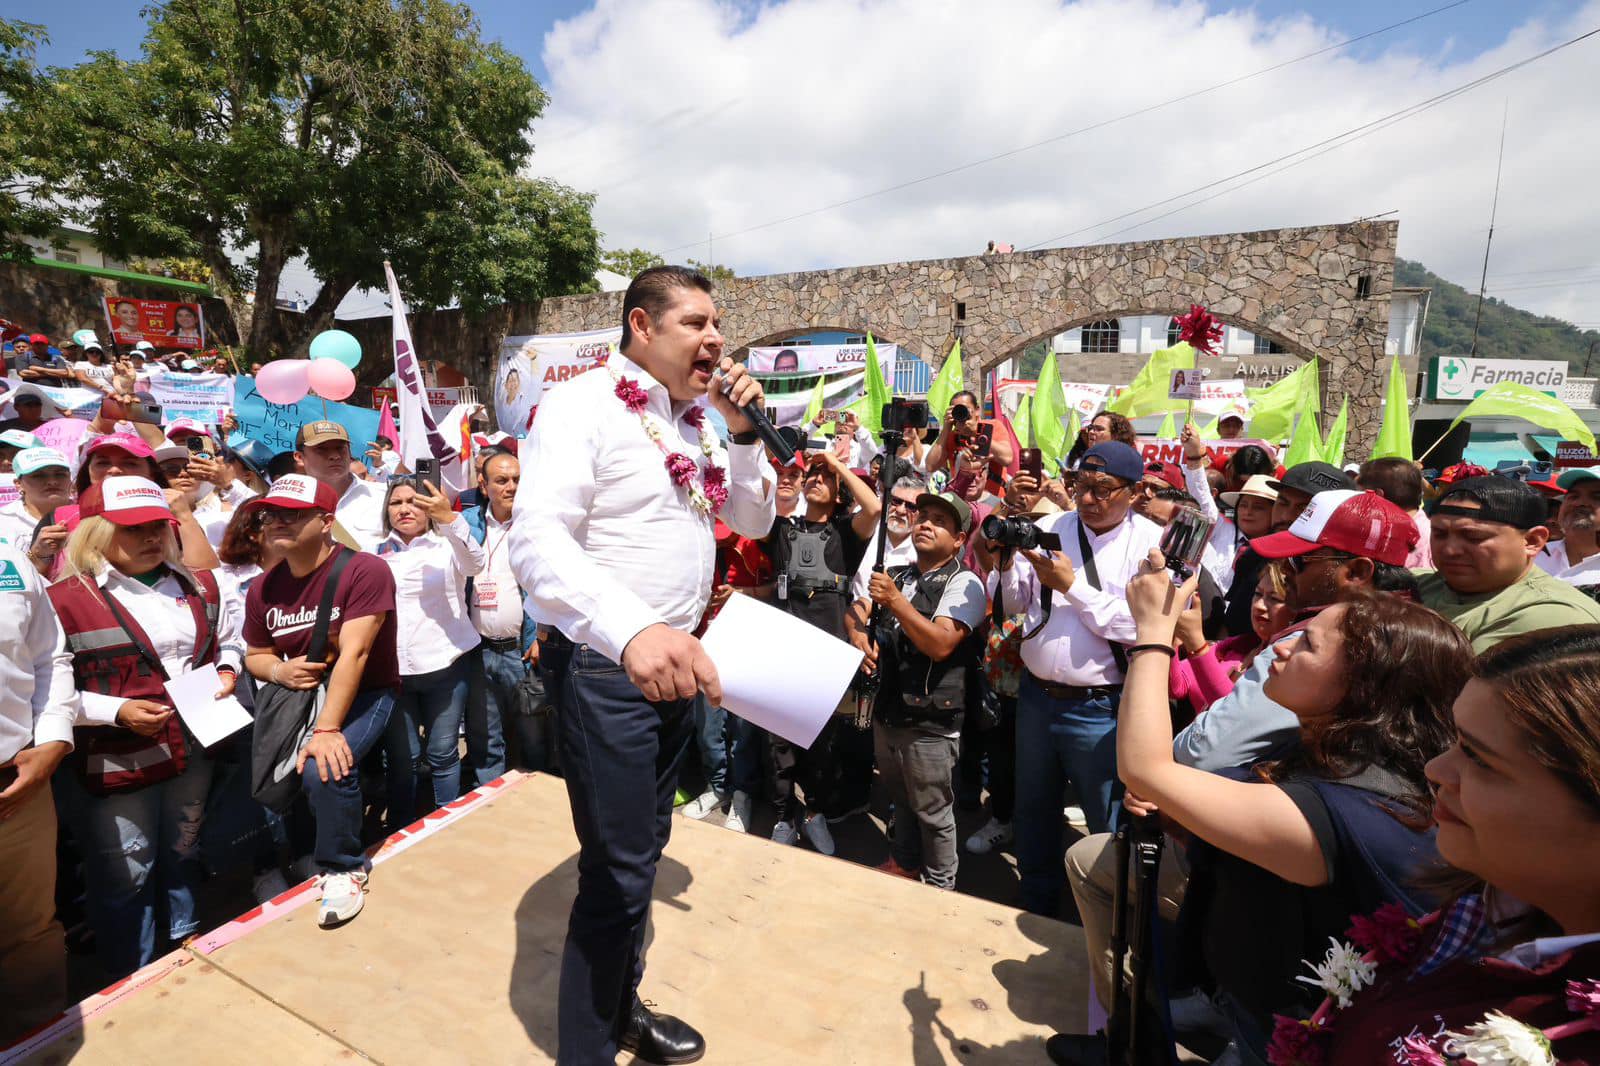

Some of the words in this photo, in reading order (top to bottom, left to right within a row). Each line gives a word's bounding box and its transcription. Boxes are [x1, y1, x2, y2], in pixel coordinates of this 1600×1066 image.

[838, 353, 866, 361] VOTA
[1470, 364, 1564, 386] Farmacia
[1309, 468, 1342, 490] VANS
